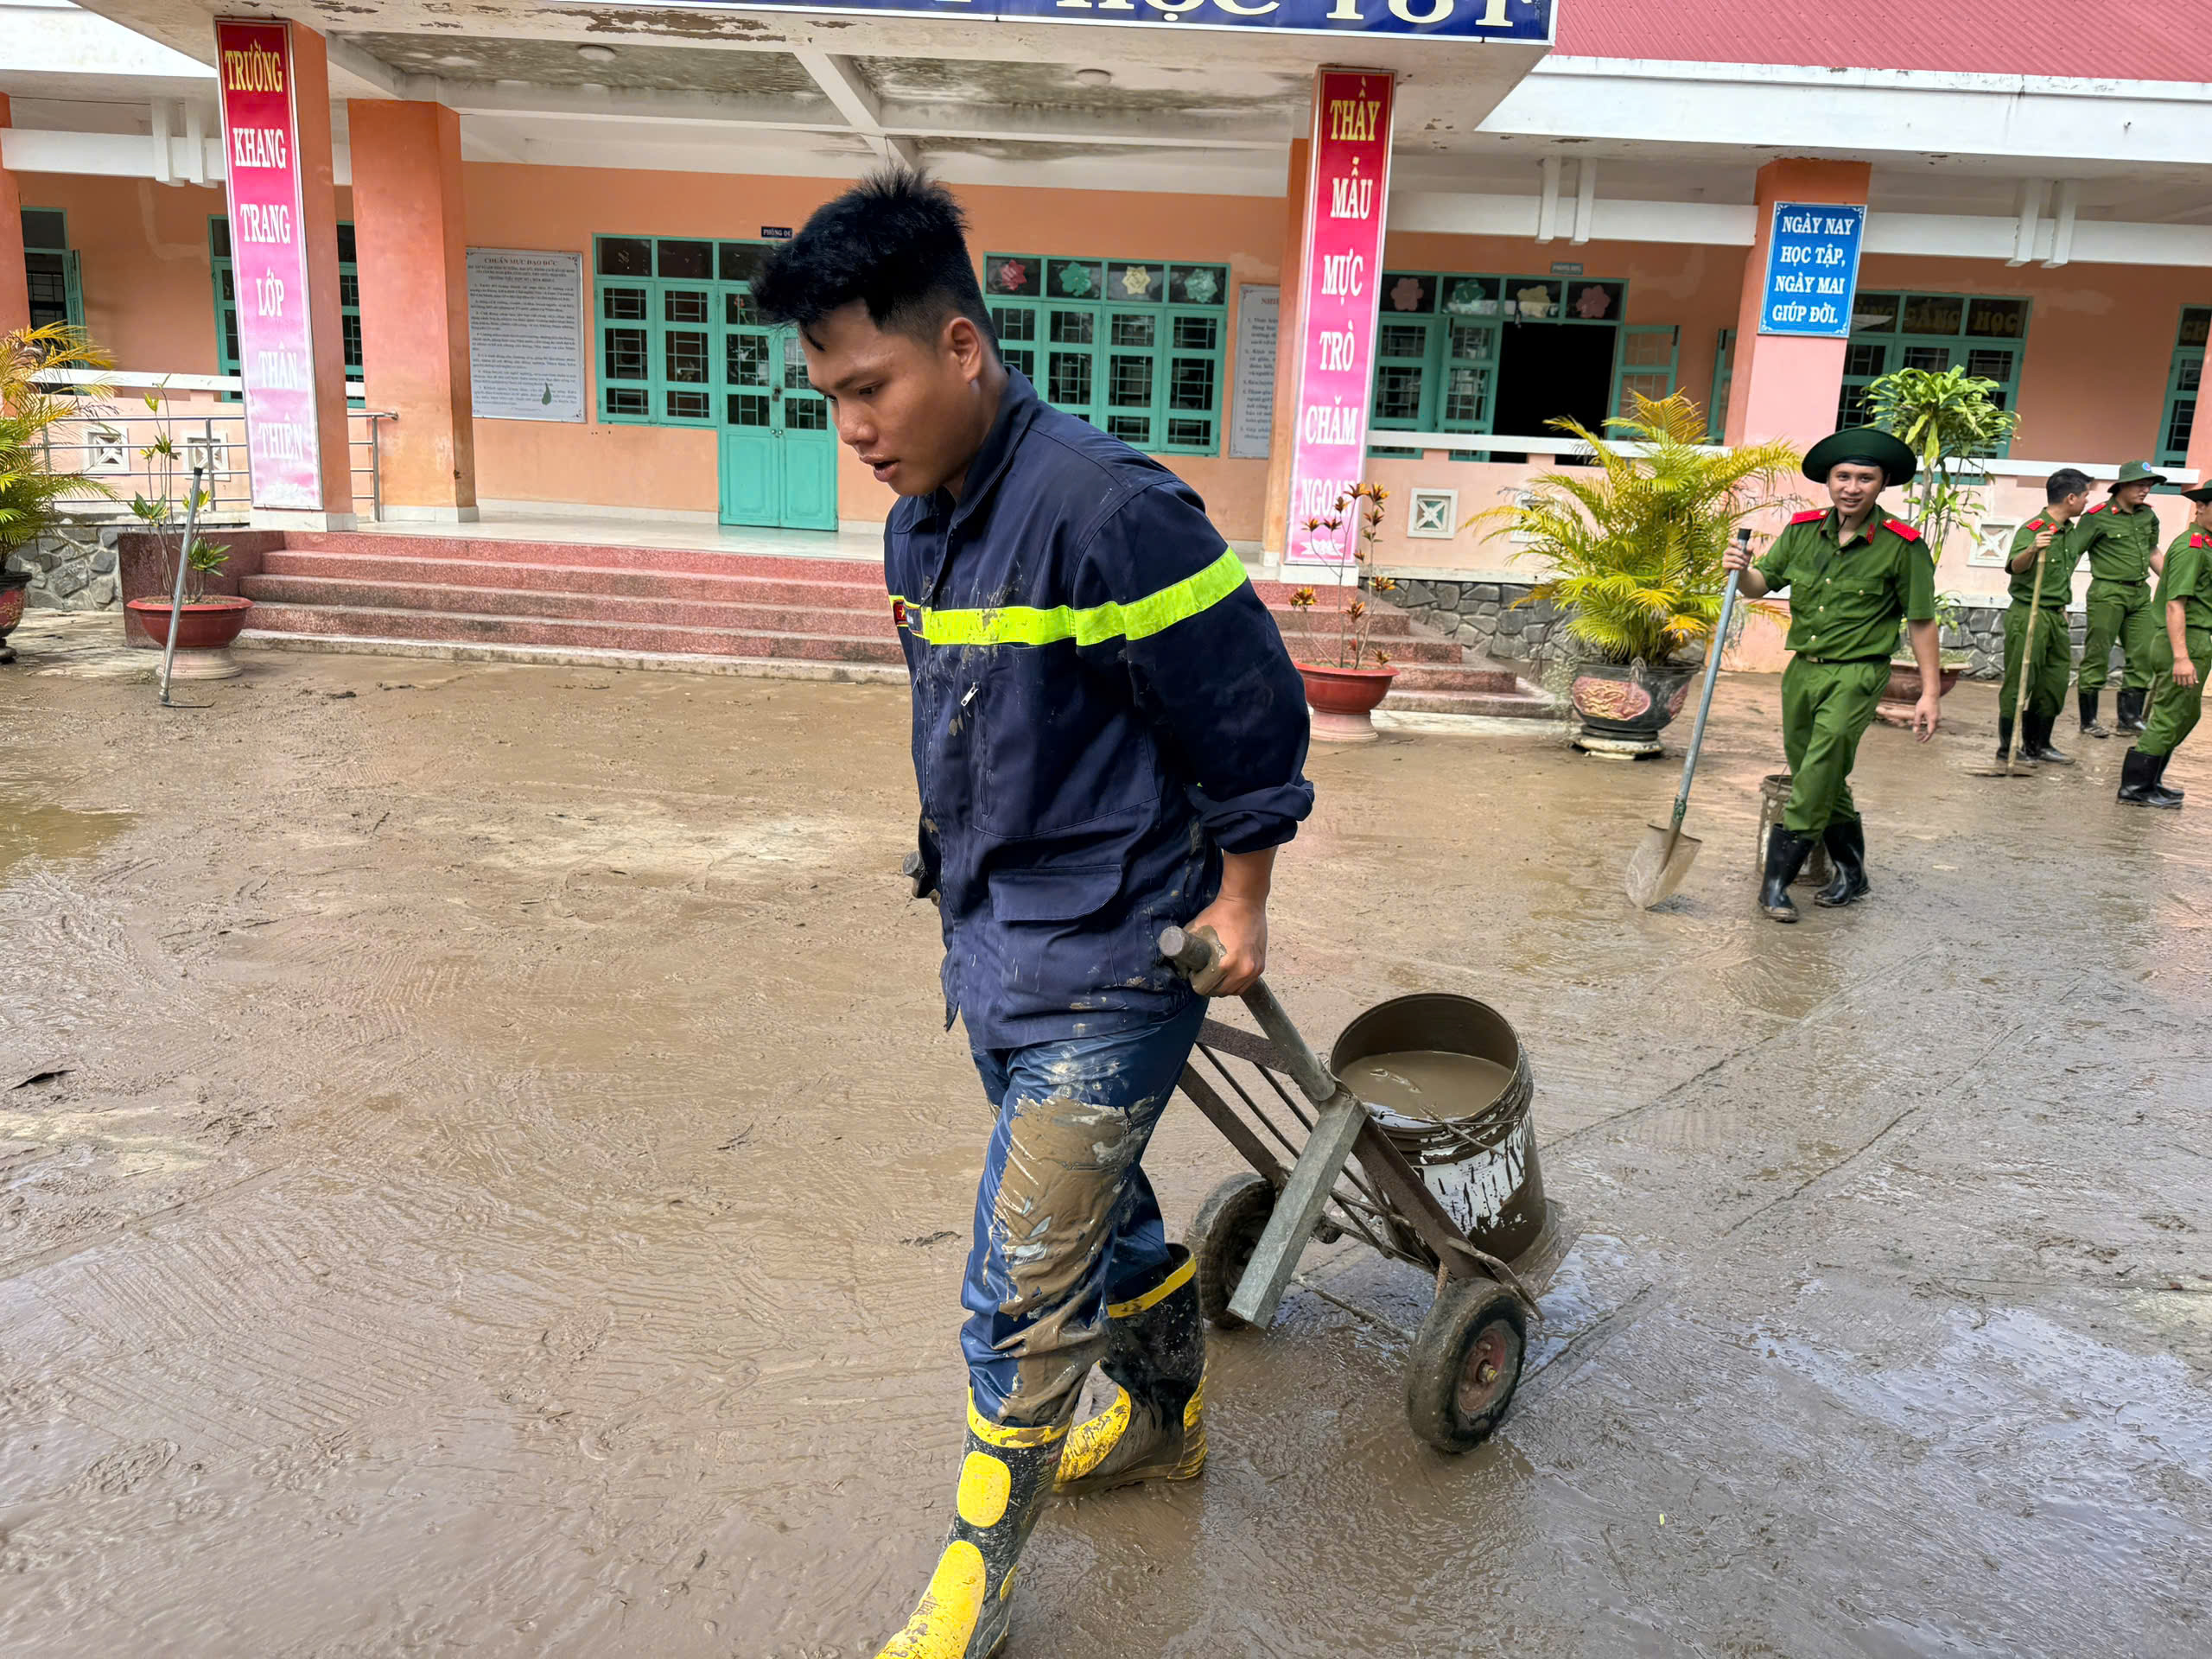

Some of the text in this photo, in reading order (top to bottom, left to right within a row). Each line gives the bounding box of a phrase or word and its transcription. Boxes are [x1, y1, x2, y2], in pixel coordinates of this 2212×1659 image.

[225, 39, 283, 92] TRƯỜNG
[1330, 76, 1381, 141] THẦY
[232, 127, 286, 168] KHANG
[1330, 156, 1373, 219] MẪU
[240, 203, 290, 244] TRANG
[1782, 212, 1854, 235] NGÀY NAY
[1321, 248, 1363, 306] MỰC
[1780, 243, 1846, 268] HỌC TẬP,
[256, 267, 284, 318] LỚP
[1774, 271, 1846, 295] NGÀY MAI
[1772, 300, 1807, 322] GIÚP
[1808, 302, 1839, 324] ĐỜI.
[258, 341, 297, 389] THÂN
[1319, 320, 1355, 372] TRÒ
[1305, 395, 1358, 446] CHĂM
